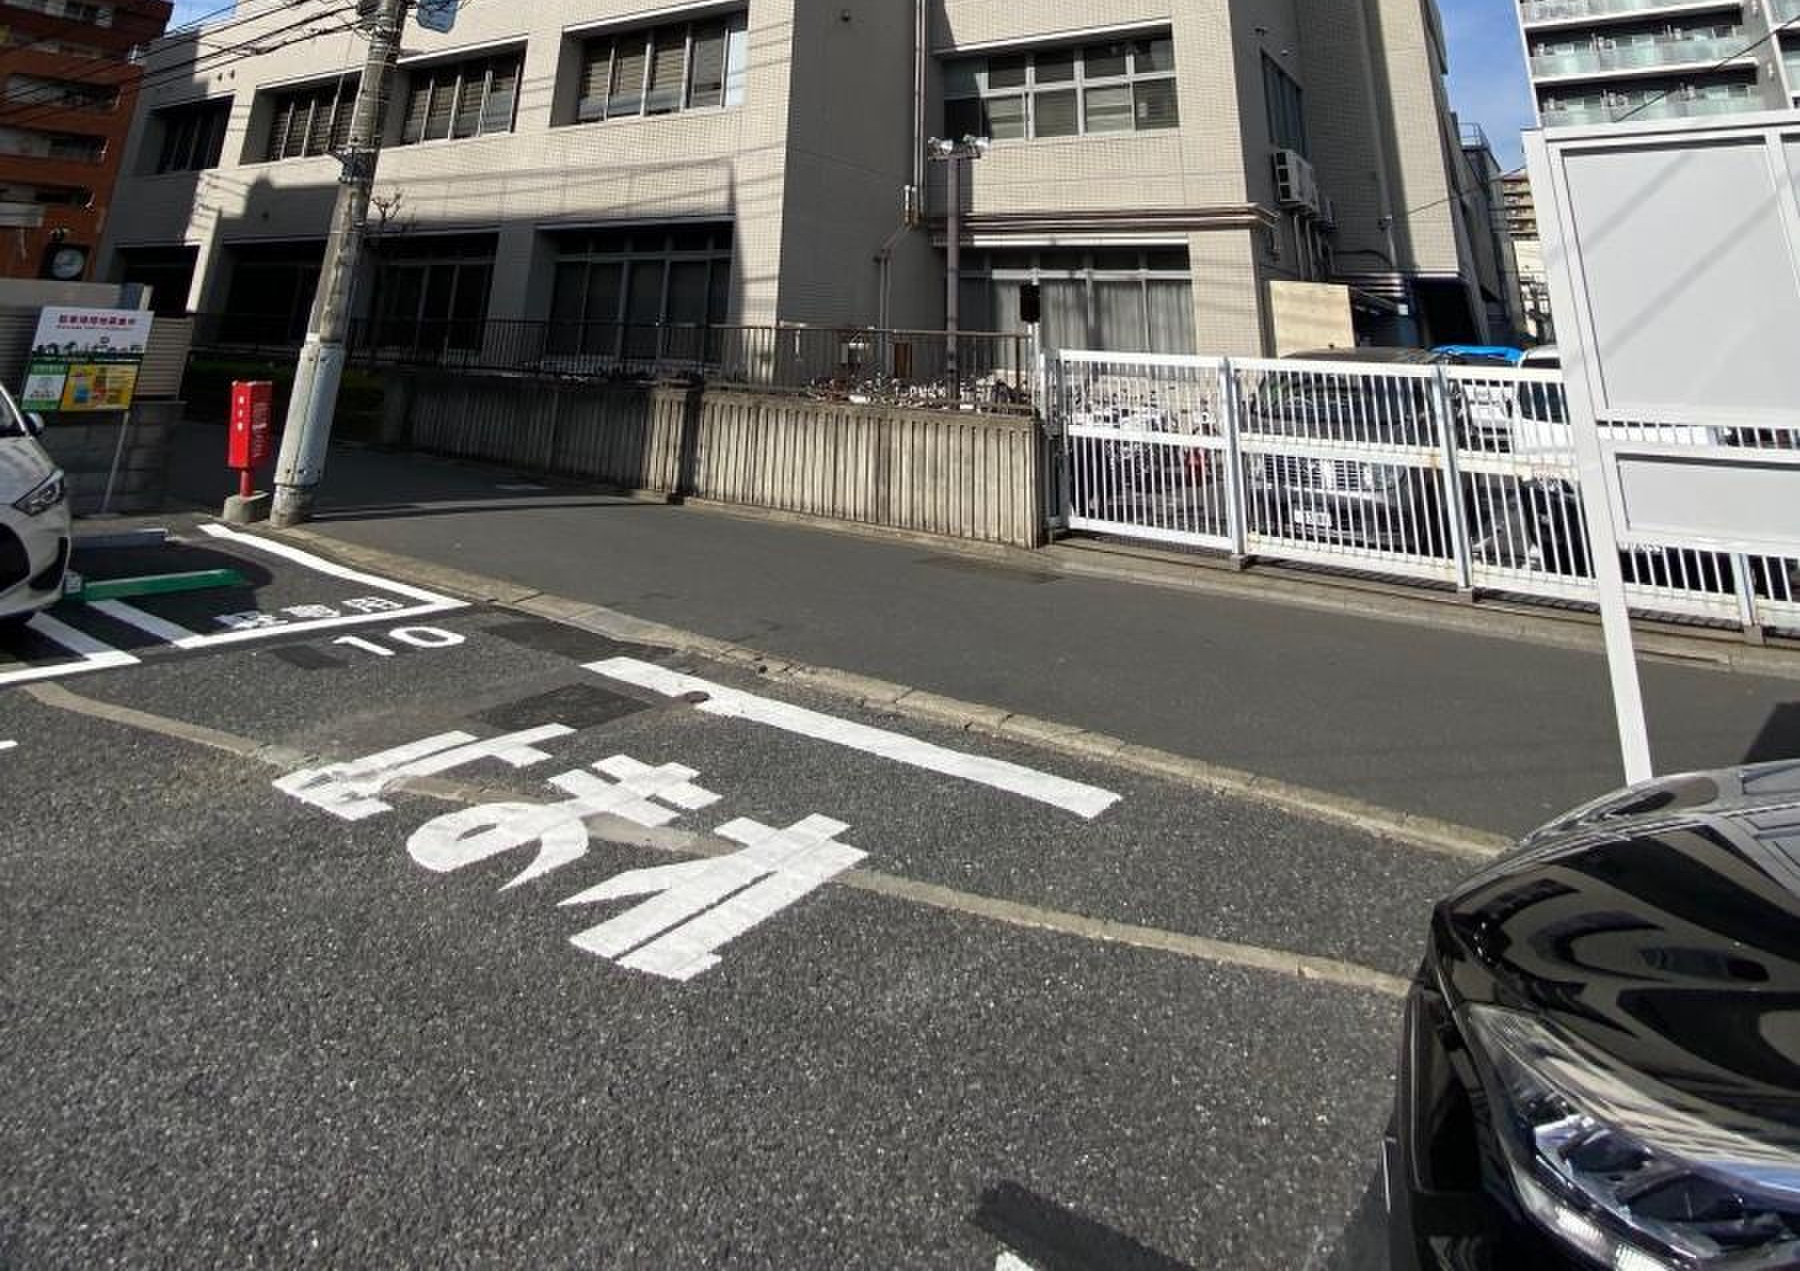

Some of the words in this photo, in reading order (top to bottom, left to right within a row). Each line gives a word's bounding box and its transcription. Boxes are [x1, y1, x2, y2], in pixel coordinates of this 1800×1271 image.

[334, 625, 466, 657] 10
[271, 722, 870, 981] とまれ
